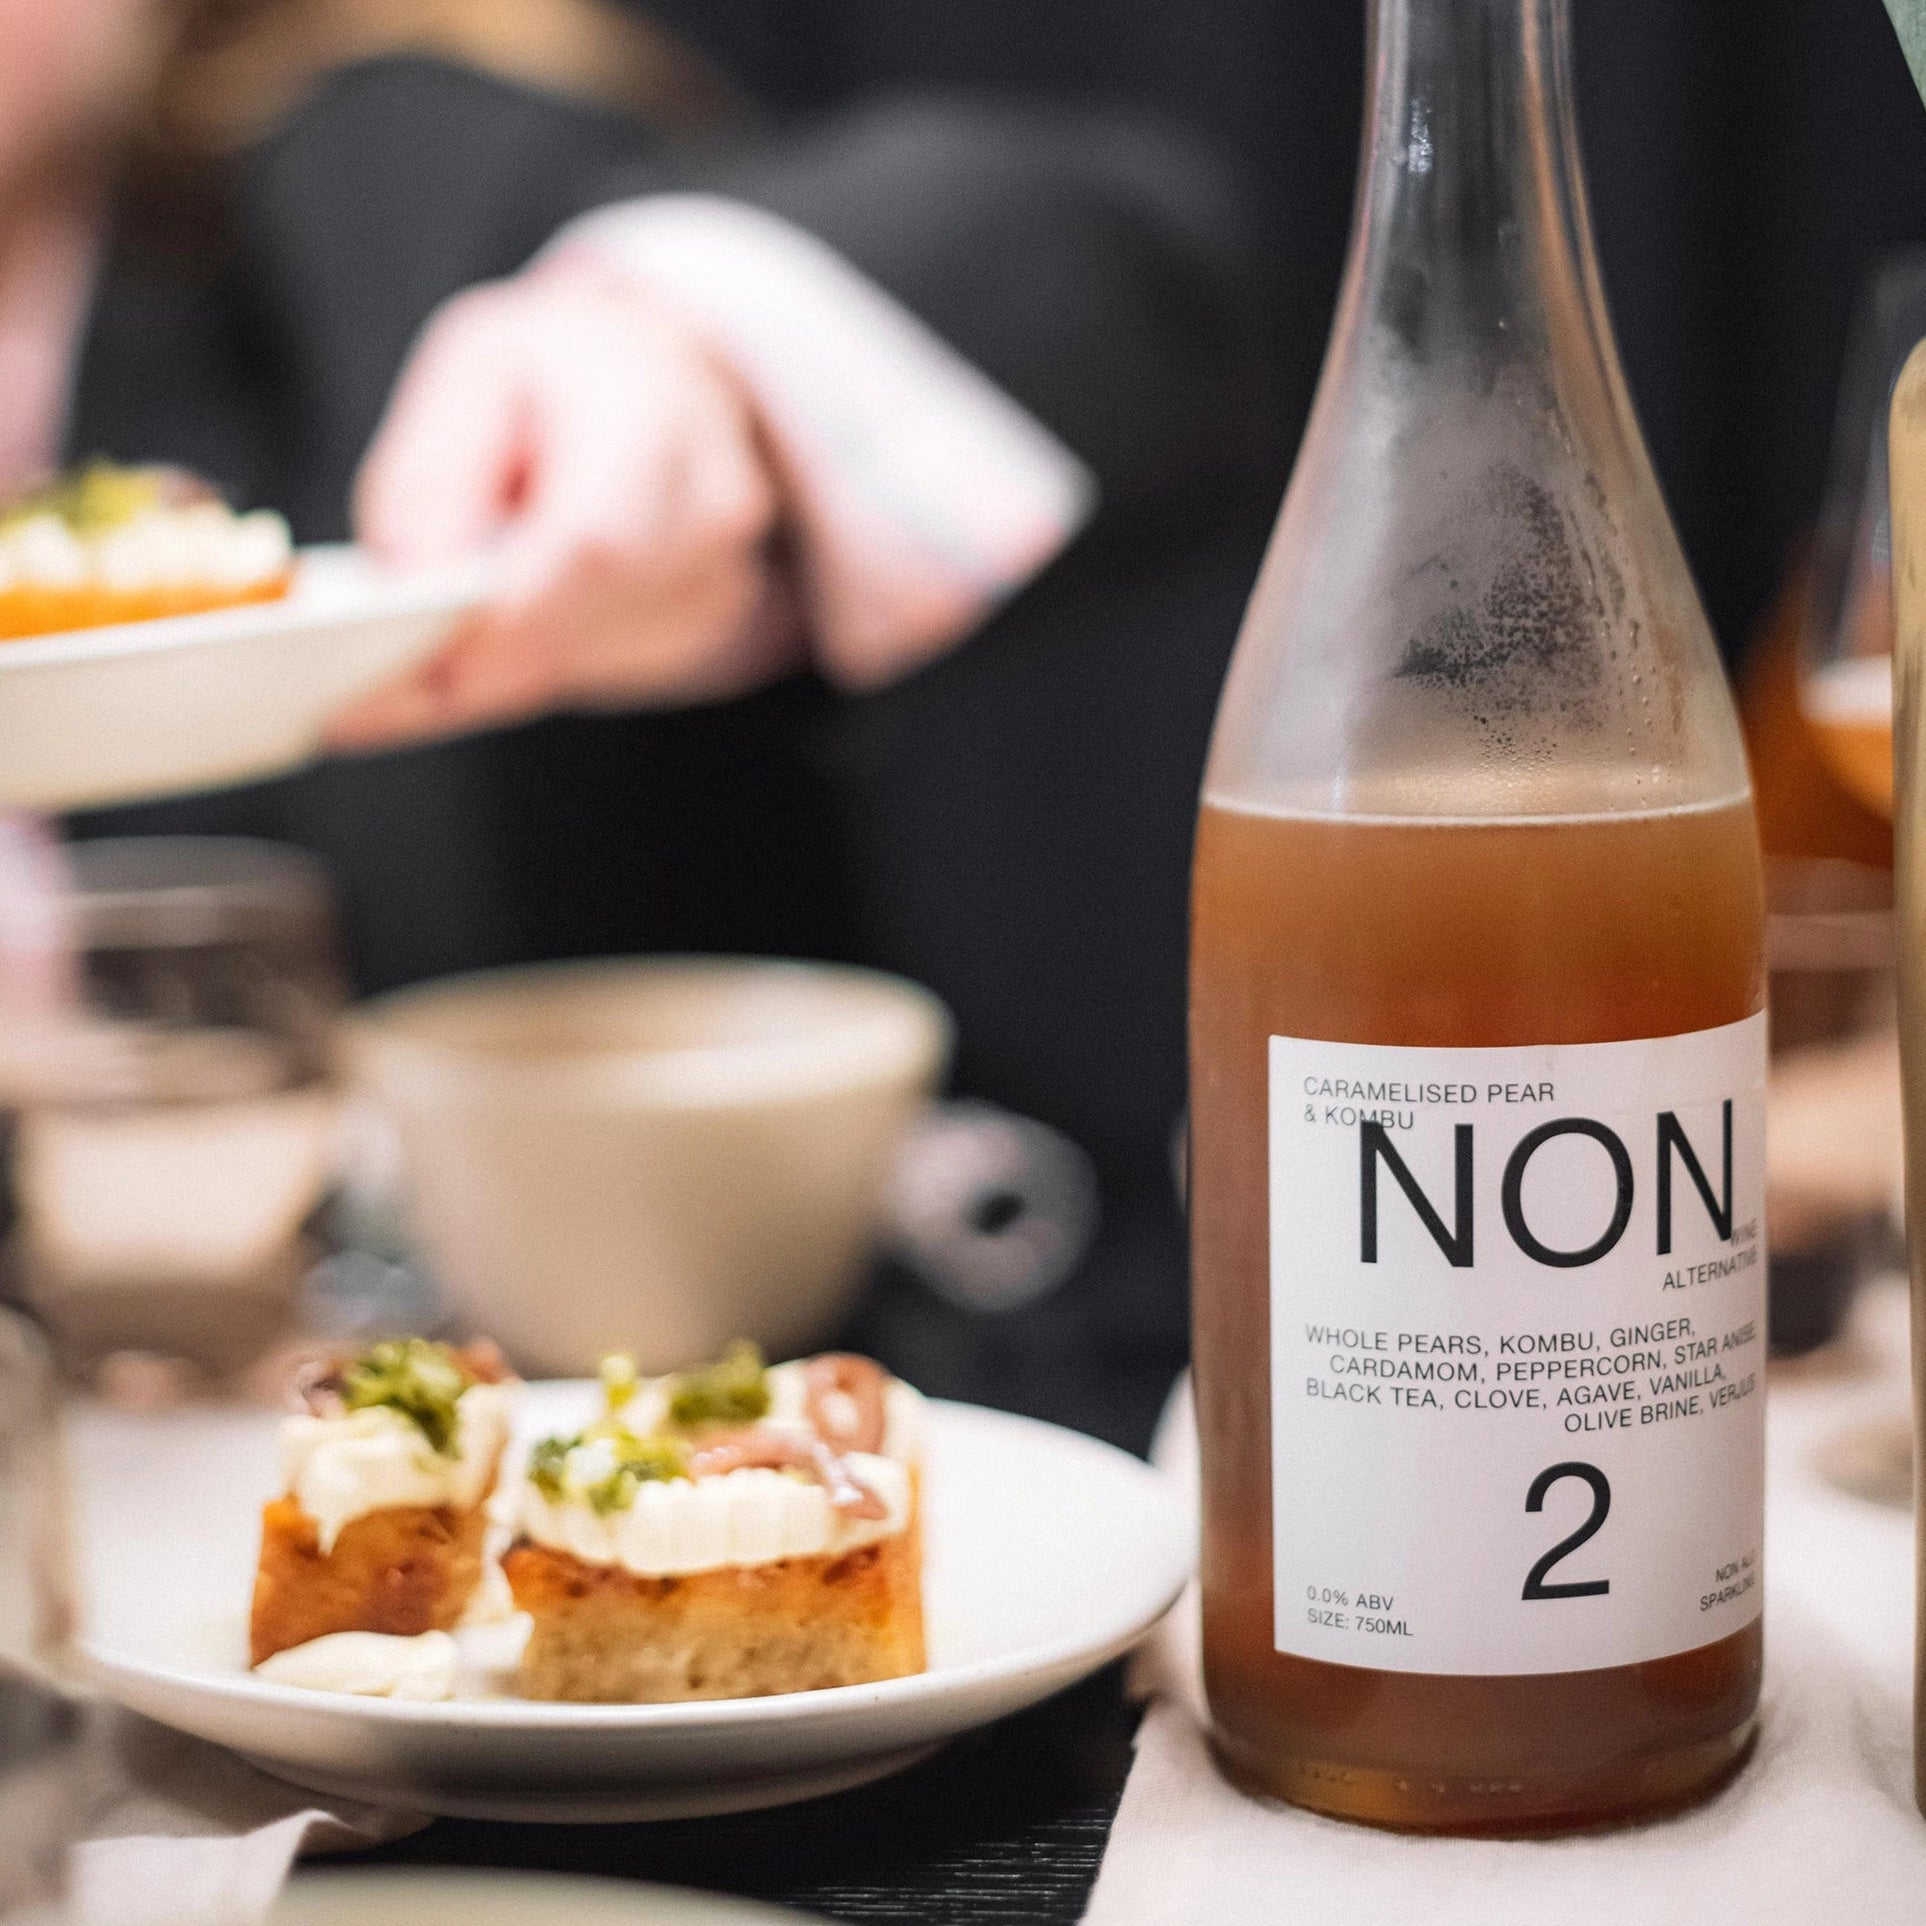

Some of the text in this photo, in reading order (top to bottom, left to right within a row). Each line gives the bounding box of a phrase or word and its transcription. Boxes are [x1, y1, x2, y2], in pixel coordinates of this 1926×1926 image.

[1304, 1076, 1554, 1103] CARAMELISED PEAR
[1304, 1104, 1414, 1130] & KOMBU
[1360, 1098, 1733, 1268] NON
[1306, 1317, 1695, 1357] WHOLE PEARS, KOMBU, GINGER,
[1330, 1355, 1485, 1384] CARDAMOM,
[1497, 1350, 1667, 1381] PEPPERCORN,
[1674, 1337, 1717, 1364] STAR
[1306, 1363, 1726, 1410] BLACK TEA, CLOVE, AGAVE, VANILLA,
[1564, 1408, 1632, 1433] OLIVE
[1641, 1395, 1704, 1424] BRINE,
[1522, 1461, 1611, 1600] 2
[1715, 1560, 1739, 1582] NON
[1306, 1585, 1394, 1610] 0.0% ABV
[1307, 1608, 1414, 1636] SIZE: 750ML
